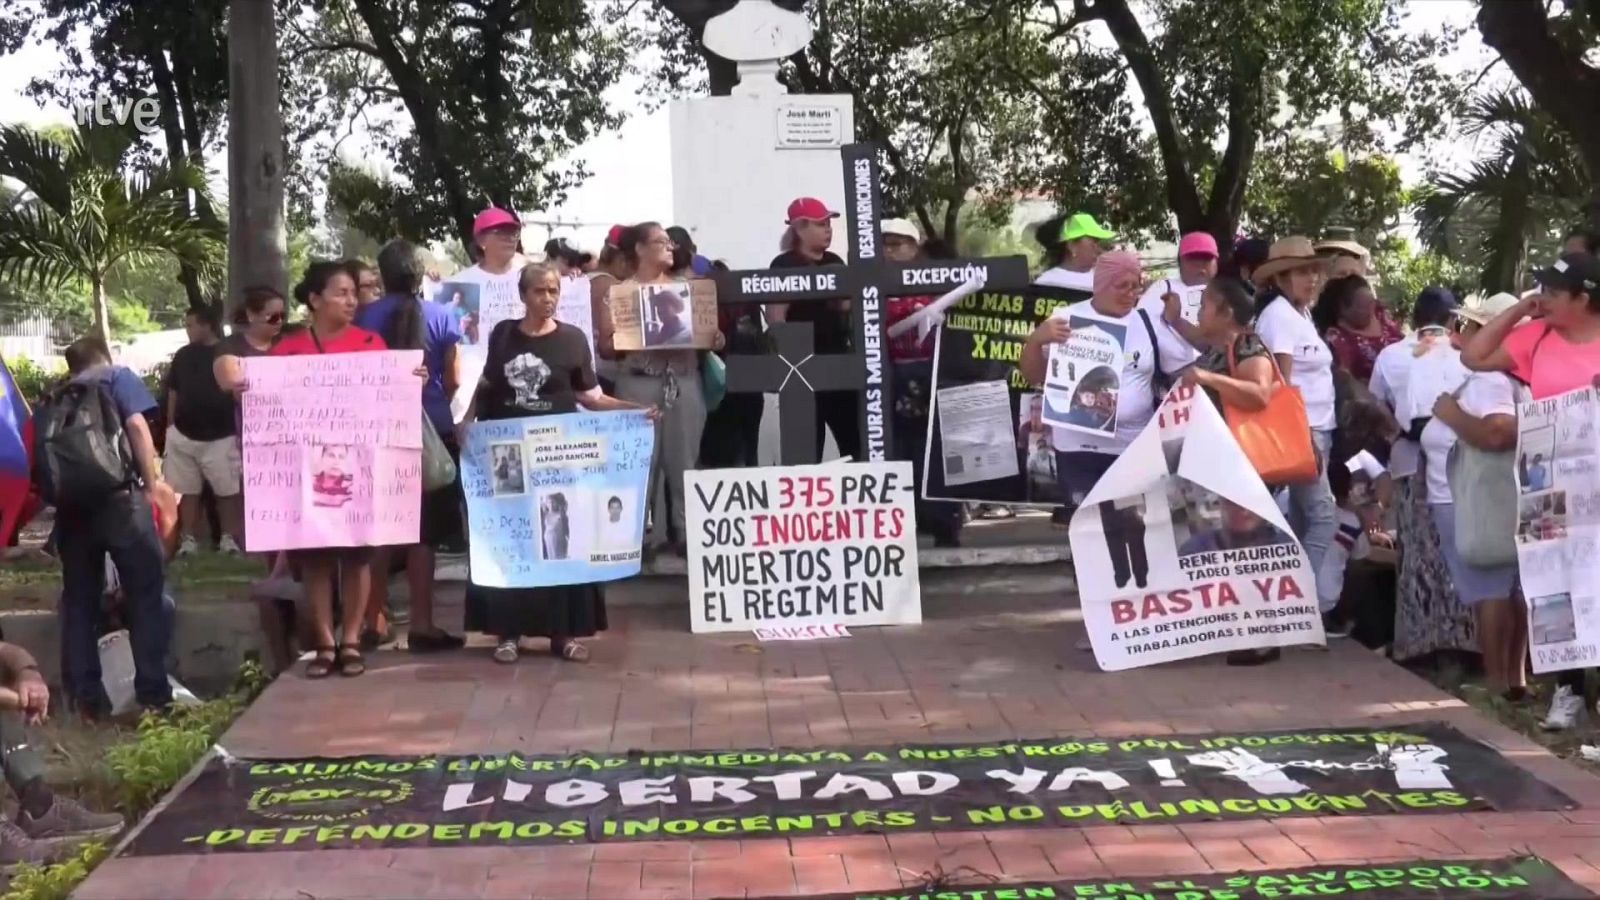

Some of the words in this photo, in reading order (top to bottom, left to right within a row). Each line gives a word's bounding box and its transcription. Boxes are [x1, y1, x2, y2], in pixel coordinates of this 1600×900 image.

[854, 157, 875, 259] DESAPARICIONES
[741, 274, 811, 294] RÉGIMEN
[816, 274, 836, 290] DE
[902, 262, 988, 286] EXCEPCIÓN
[982, 293, 1024, 314] MAS
[862, 285, 883, 384] MUERTES
[947, 313, 1001, 333] LIBERTAD
[971, 333, 987, 358] X
[989, 340, 1026, 361] MAR
[866, 389, 885, 464] RTURAS
[555, 442, 598, 451] ALEXANDER
[565, 452, 600, 461] SANCHEZ
[694, 480, 769, 513] VAN
[779, 477, 834, 509] 375
[841, 473, 914, 504] PRE-
[702, 517, 745, 548] SOS
[751, 508, 905, 546] INOCENTES
[702, 547, 832, 588] MUERTOS
[844, 545, 905, 580] POR
[1179, 553, 1219, 569] RENE
[1224, 545, 1300, 565] MAURICIO
[1187, 567, 1230, 581] TADEO
[1235, 559, 1301, 576] SERRANO
[704, 592, 732, 623] EL
[744, 580, 884, 620] REGIMEN
[1111, 581, 1240, 625] BASTA
[1252, 575, 1304, 602] YA
[1111, 632, 1119, 641] A
[1124, 627, 1150, 639] LAS
[1155, 612, 1238, 633] DETENCIONES
[1244, 612, 1252, 620] A
[1126, 628, 1233, 655] TRABAJADORAS
[1238, 627, 1243, 636] E
[1248, 621, 1312, 635] INOCENTES
[250, 759, 436, 775] EXIJIMOS
[448, 754, 628, 771] LIBERTAD
[640, 749, 852, 768] INMEDIATA
[862, 751, 889, 762] A
[899, 742, 1110, 760] NUESTR@S
[443, 770, 960, 811] LIBERTAD
[985, 766, 1130, 794] YA
[603, 810, 916, 836] INOCENTES
[967, 805, 1044, 824] NO
[1058, 789, 1468, 820] DELINCUENTES
[1074, 882, 1135, 896] EN
